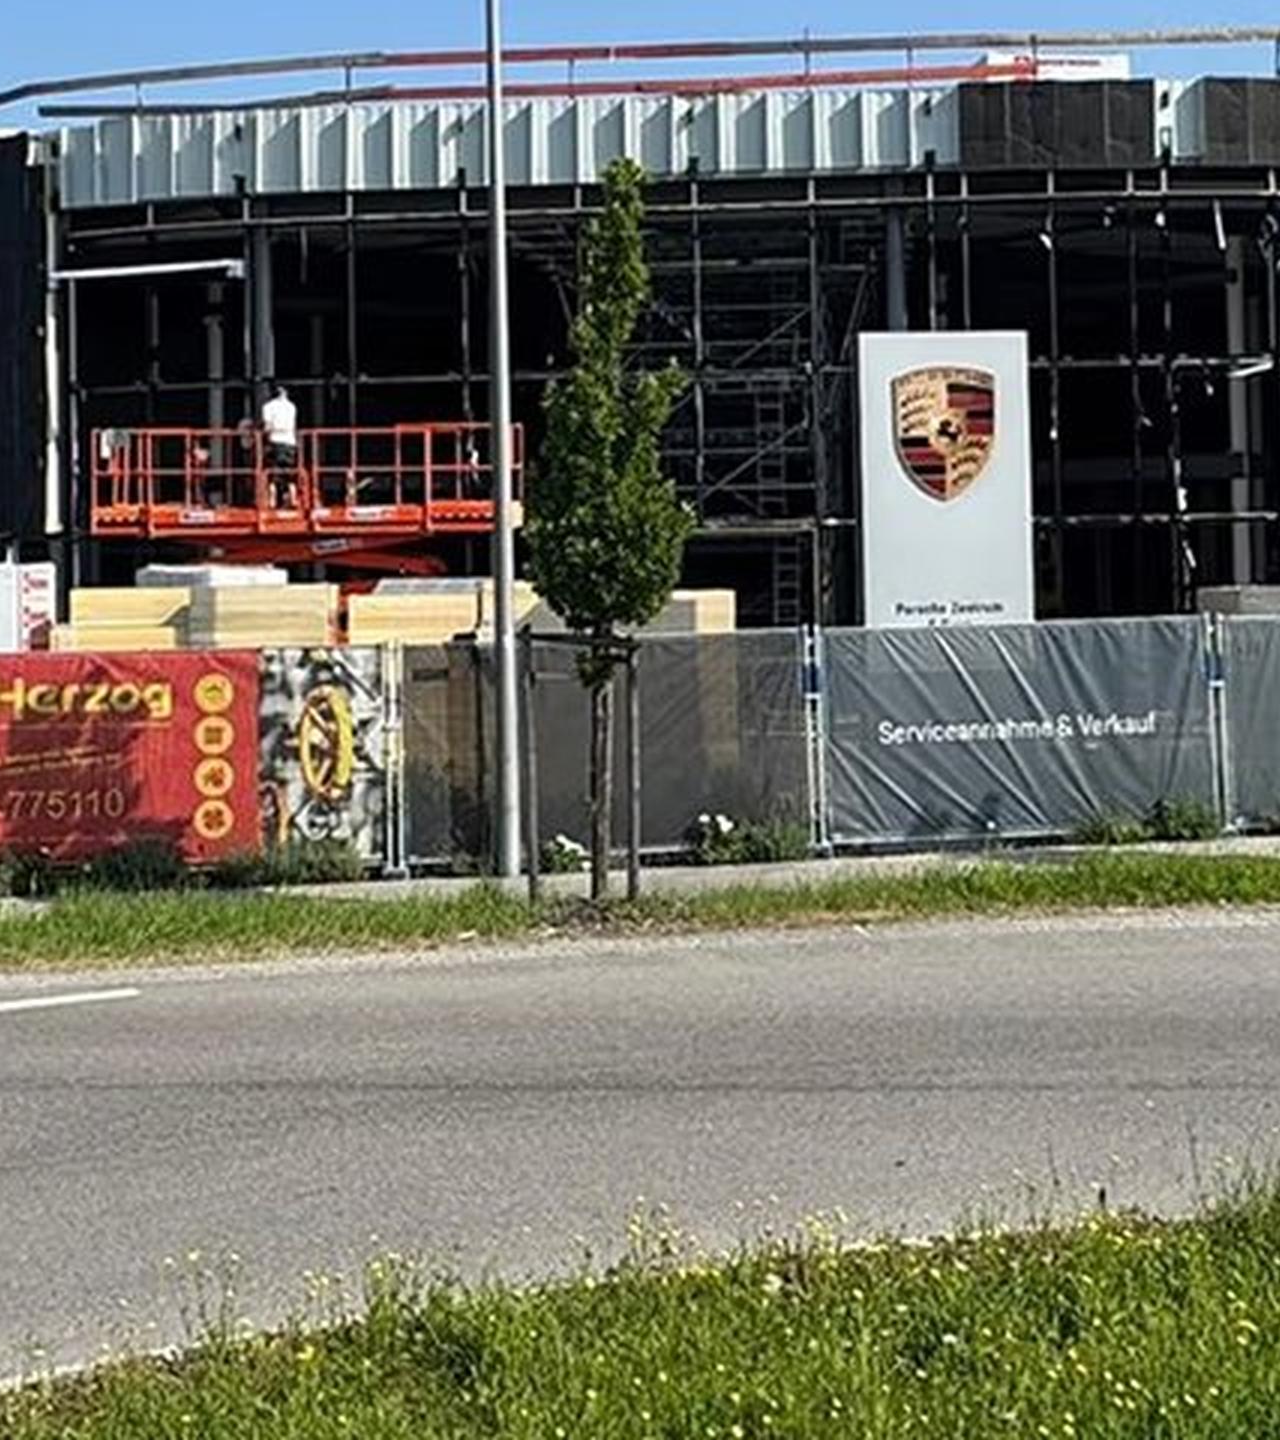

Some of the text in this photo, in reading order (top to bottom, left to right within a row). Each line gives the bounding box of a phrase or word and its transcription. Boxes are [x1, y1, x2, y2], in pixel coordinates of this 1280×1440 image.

[878, 710, 1157, 746] Serviceannahme & Verkauf
[8, 787, 125, 818] 775110
